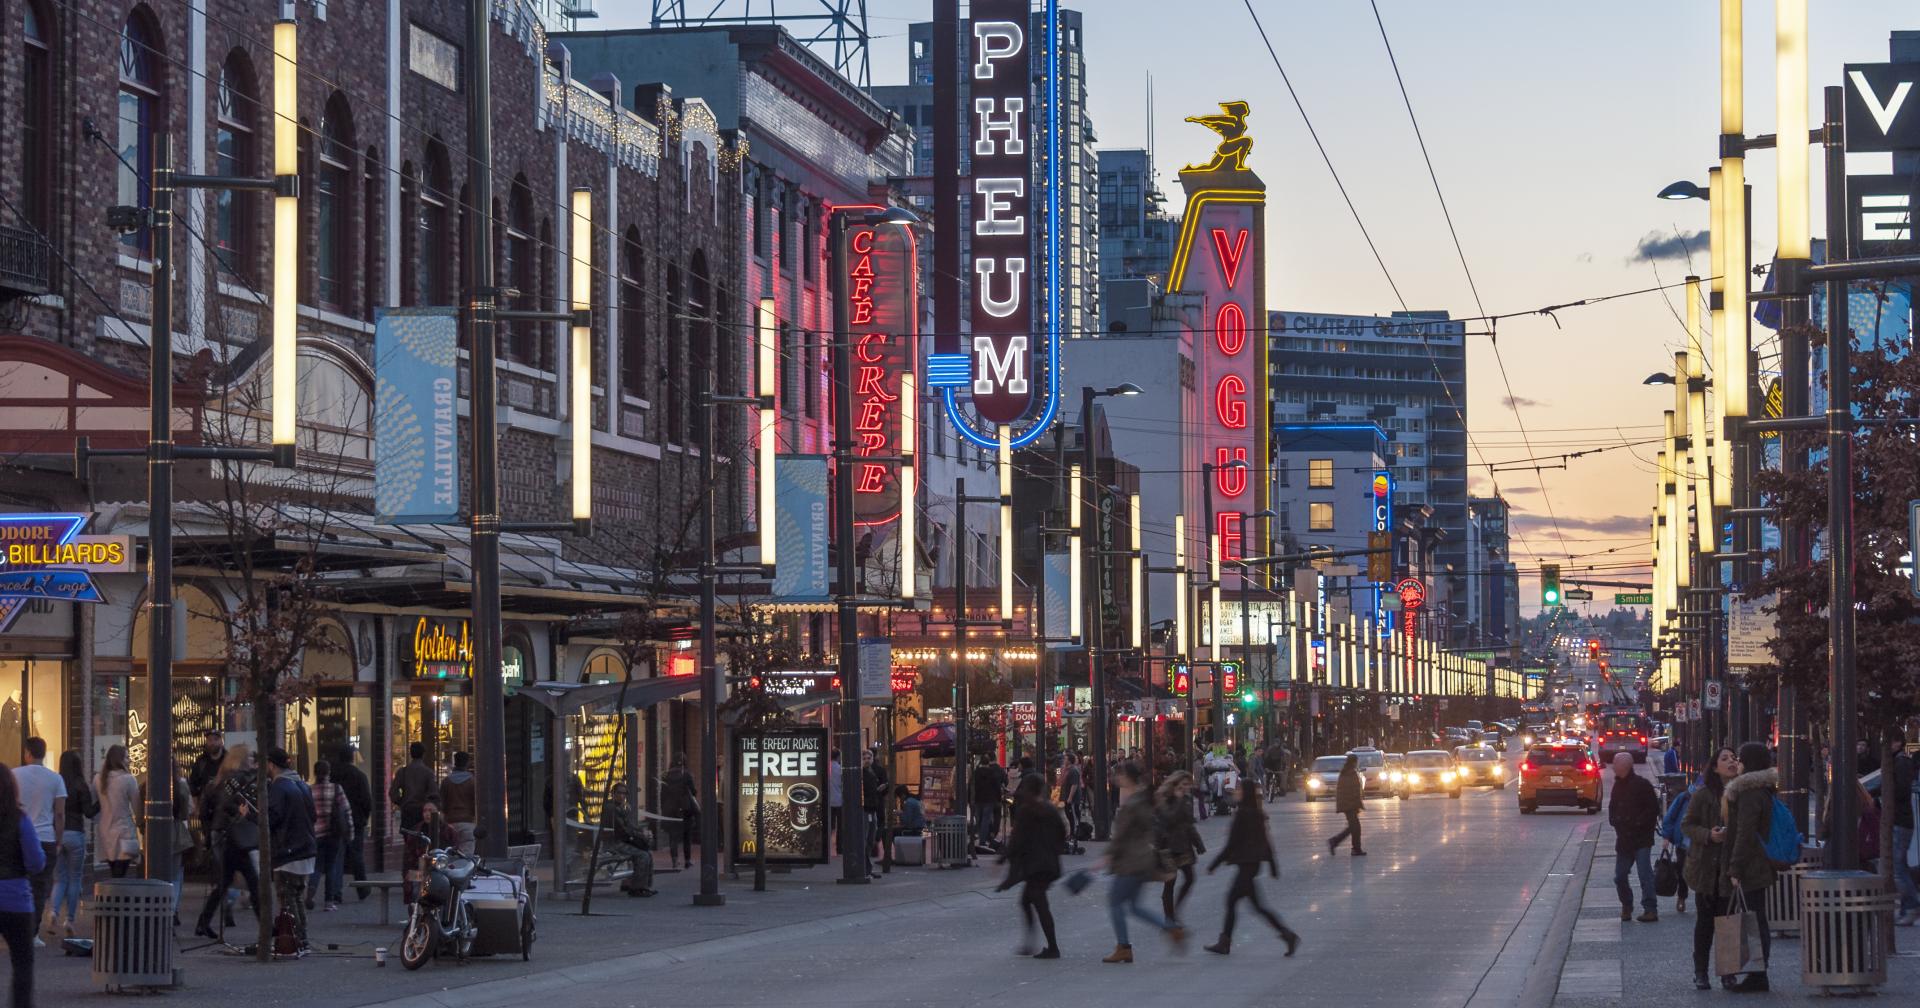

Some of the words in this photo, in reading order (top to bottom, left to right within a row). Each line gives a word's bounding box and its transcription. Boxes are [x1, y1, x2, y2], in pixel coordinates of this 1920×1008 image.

[1293, 315, 1365, 338] CHATEAU
[1212, 228, 1249, 563] VOGUE
[9, 542, 124, 565] BILLIARDS
[1620, 593, 1650, 604] Smithe
[917, 613, 934, 622] TE
[945, 613, 993, 622] SYPHONY
[415, 616, 457, 677] Golden
[742, 738, 757, 749] THE
[762, 738, 791, 749] ERFECT
[793, 738, 819, 750] ROAST.
[743, 752, 818, 777] FREE
